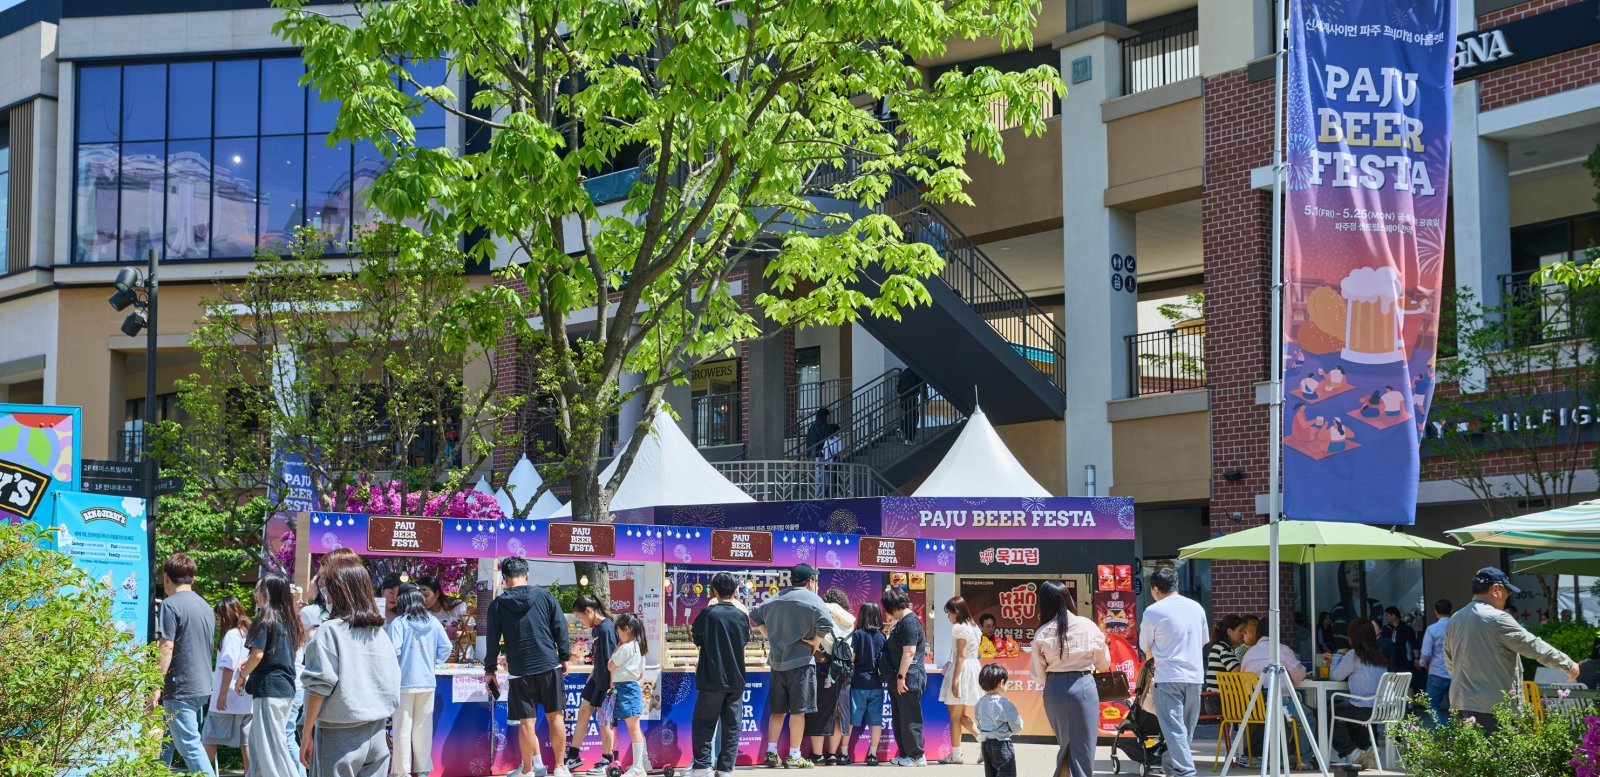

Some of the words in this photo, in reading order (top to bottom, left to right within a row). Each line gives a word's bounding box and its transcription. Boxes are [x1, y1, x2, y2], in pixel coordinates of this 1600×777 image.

[1305, 18, 1357, 37] 신세계사이먼
[1360, 25, 1381, 37] 파주
[1383, 25, 1413, 43] 프리미엄
[1414, 32, 1444, 46] 아울렛
[1325, 64, 1420, 107] PAJU
[1317, 107, 1425, 153] BEER
[1310, 150, 1436, 197] FESTA
[1304, 205, 1335, 218] 5.1(FRI)
[1343, 208, 1395, 221] 5.25(MON)
[1335, 222, 1356, 231] 파주점
[284, 473, 312, 487] PAJU
[289, 487, 313, 500] EER
[920, 510, 968, 529] PAJU
[972, 510, 1027, 527] BEER
[1032, 510, 1096, 527] FESTA
[394, 521, 416, 531] PAJU
[393, 530, 417, 539] BEER
[572, 527, 591, 536] PAJU
[570, 535, 592, 544] BEER
[733, 534, 750, 542] PAJU
[391, 539, 420, 548] FESTA
[569, 544, 595, 552] FESTA
[731, 542, 752, 550] BEER
[879, 541, 895, 549] PAJU
[730, 549, 754, 558] FESTA
[878, 548, 896, 556] BEER
[996, 549, 1038, 564] 묵끄럽
[876, 556, 898, 564] FESTA
